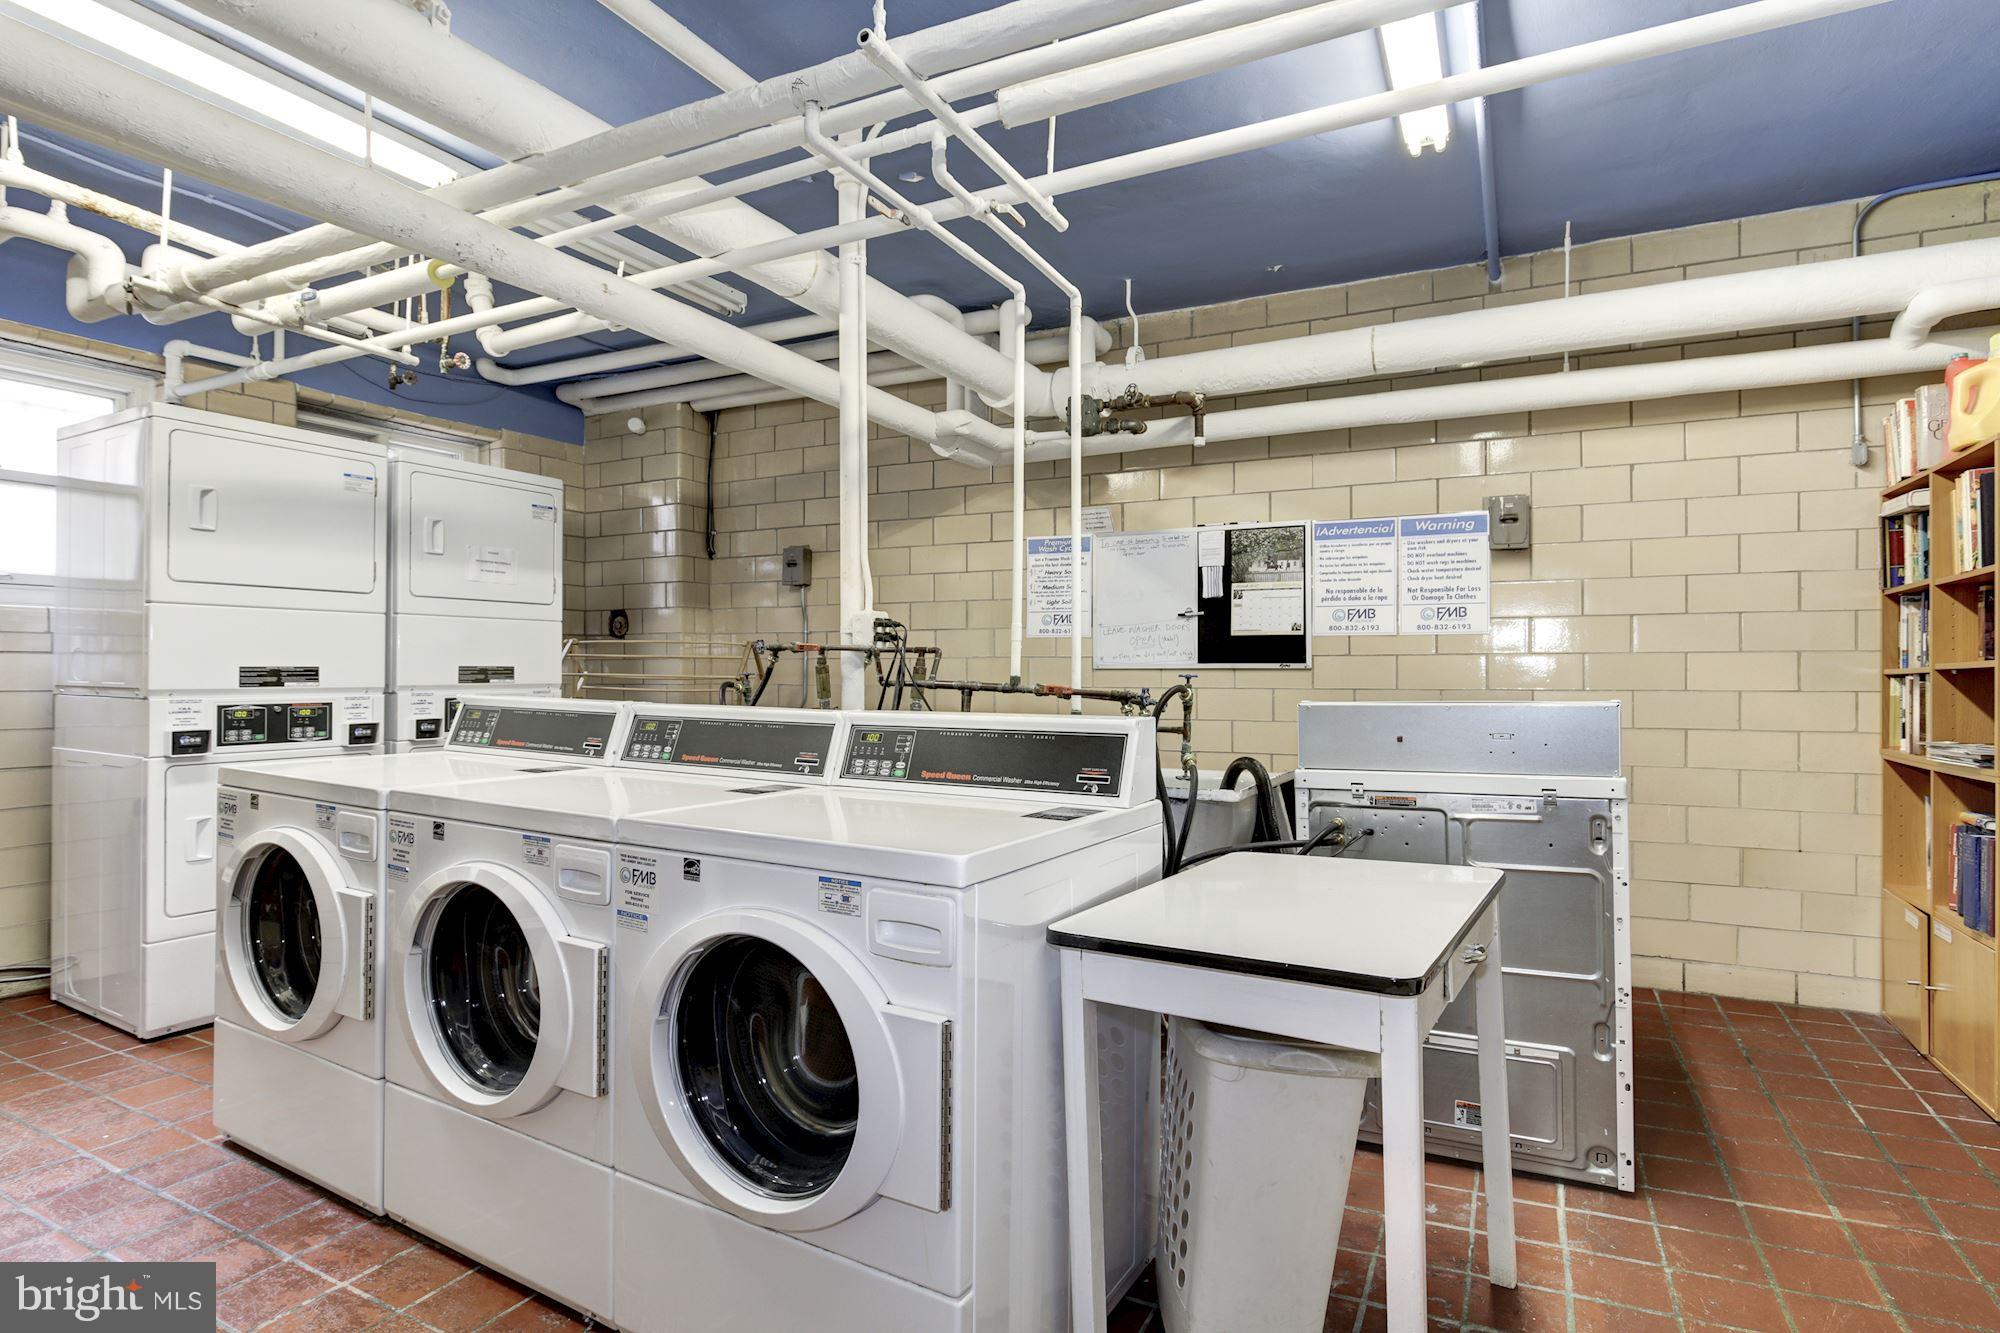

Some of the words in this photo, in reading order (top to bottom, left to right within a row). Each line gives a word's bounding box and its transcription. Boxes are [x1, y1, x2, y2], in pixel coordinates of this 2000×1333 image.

[1416, 519, 1474, 531] Warning
[1335, 587, 1367, 596] responsable
[1347, 608, 1376, 622] FMB
[1437, 607, 1467, 621] FMB
[921, 771, 946, 779] Speed
[946, 771, 971, 781] Queen
[972, 774, 1002, 783] Commercial
[398, 831, 414, 844] FMB
[632, 869, 656, 885] FMB
